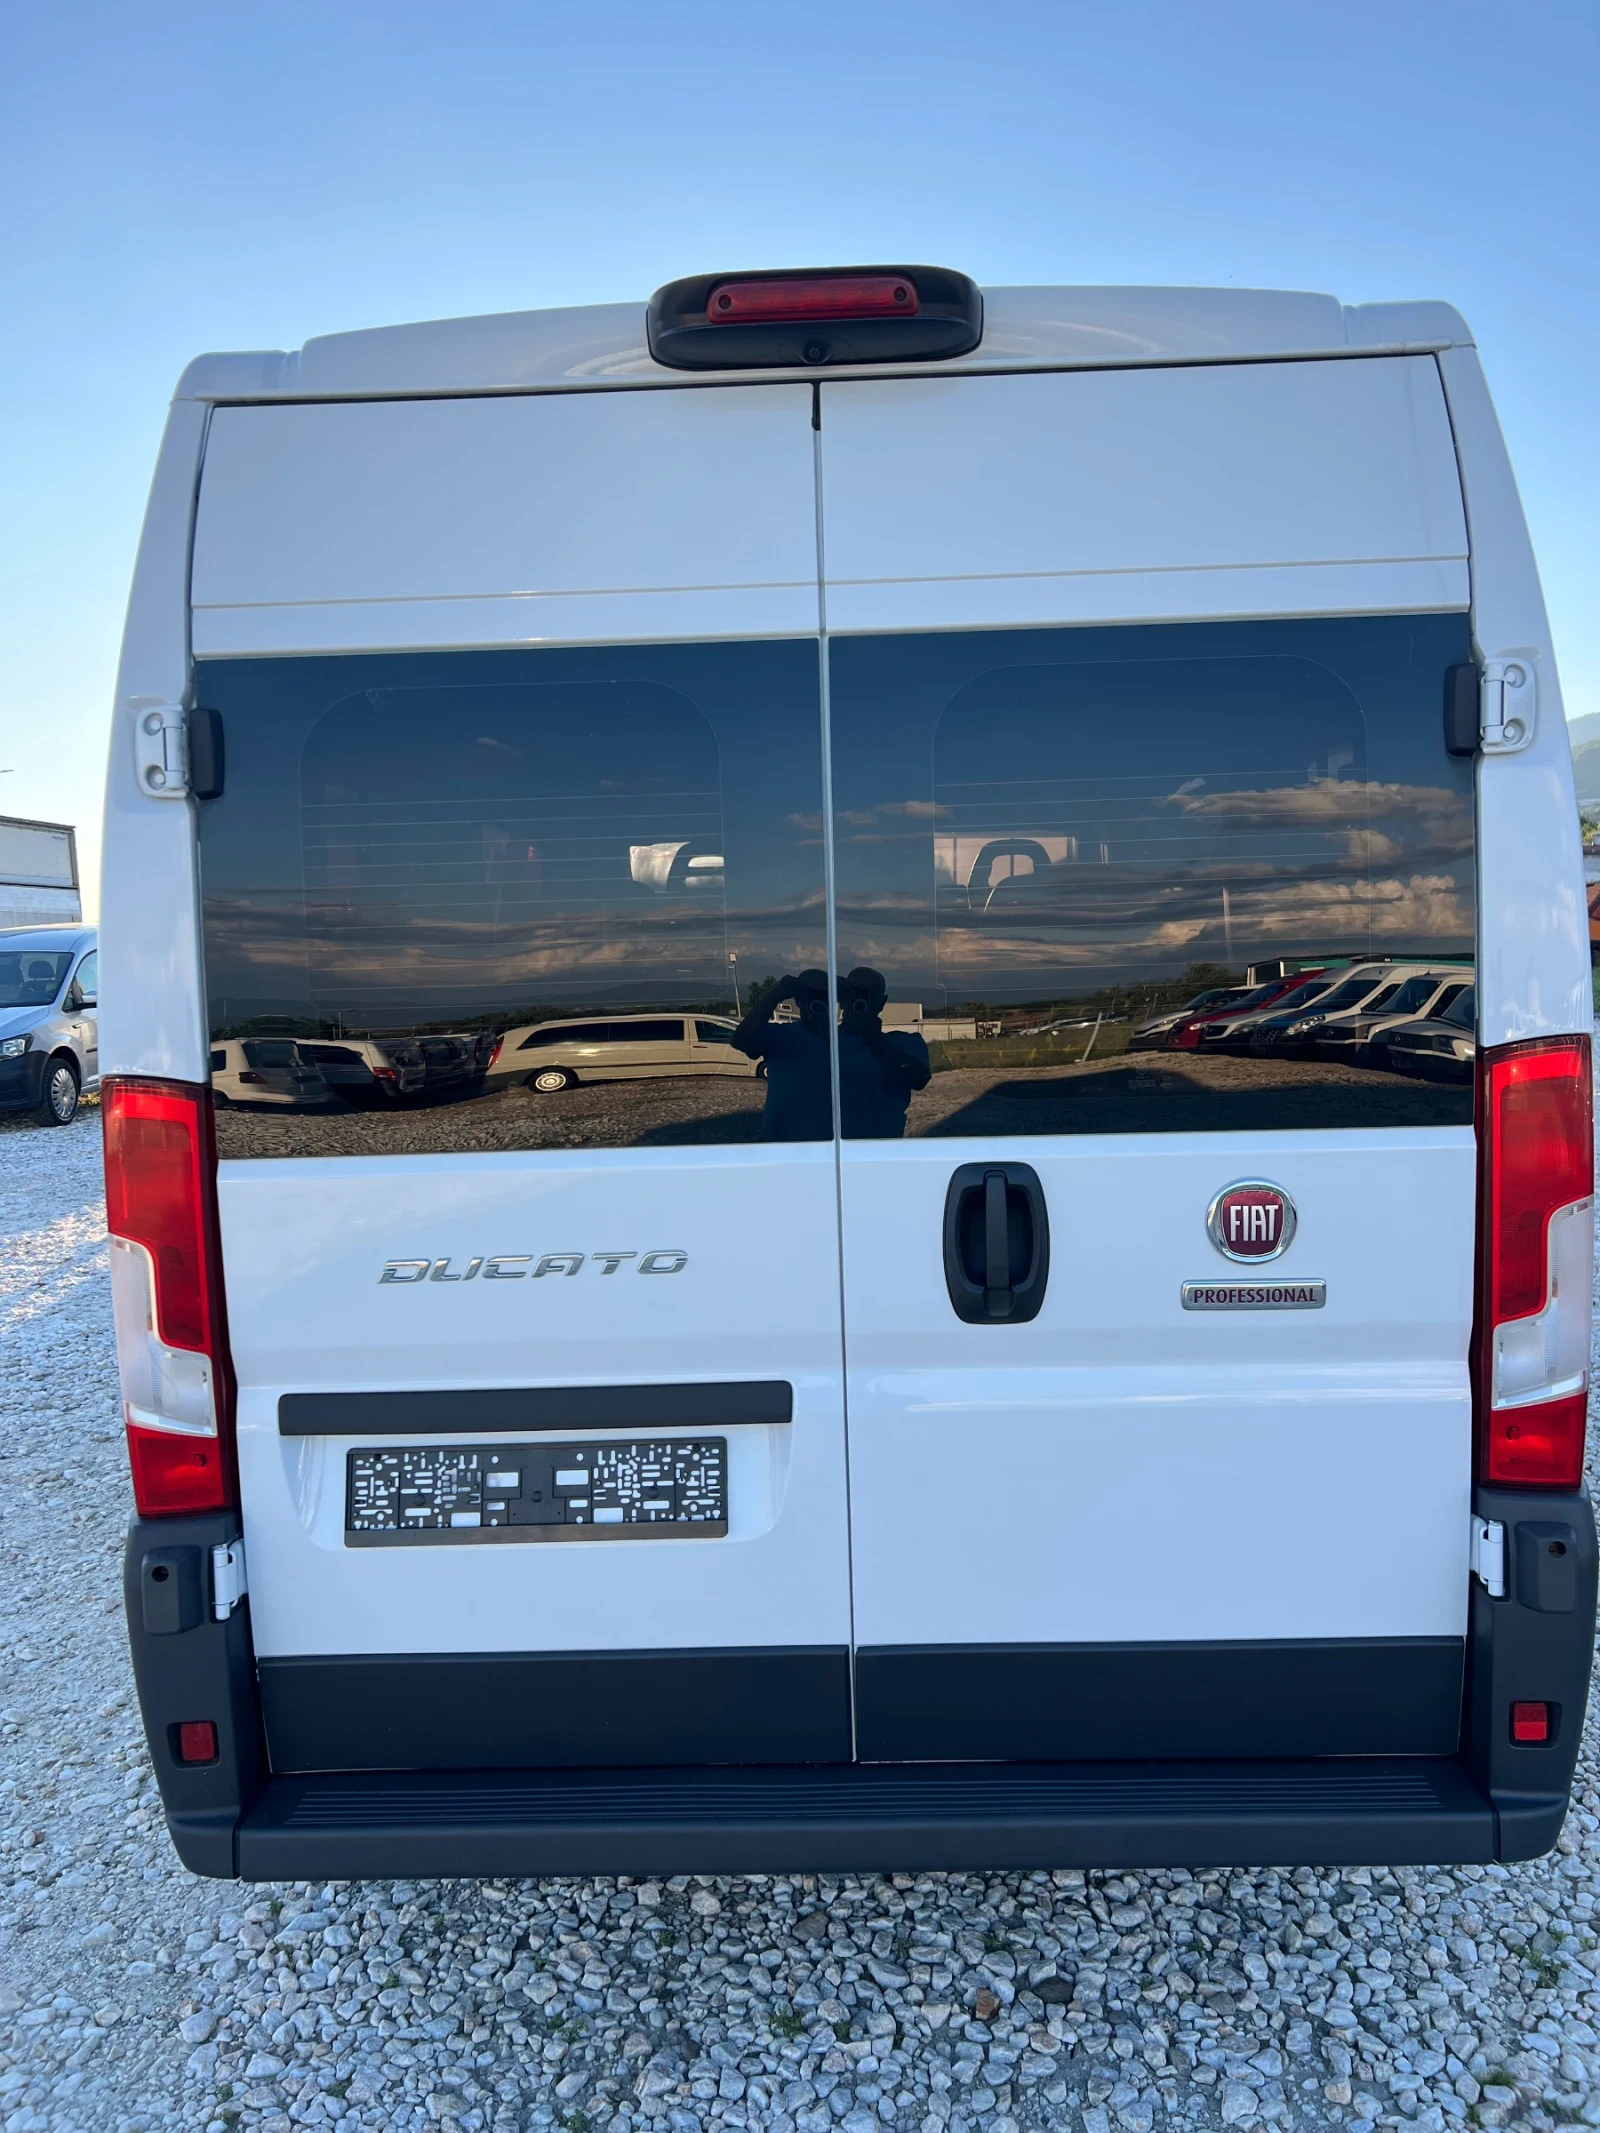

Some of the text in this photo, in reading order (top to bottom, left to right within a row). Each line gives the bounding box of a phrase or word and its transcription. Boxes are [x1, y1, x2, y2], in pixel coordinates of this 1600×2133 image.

[1229, 1204, 1279, 1242] FIAT
[377, 1249, 689, 1284] DUCATO
[1193, 1287, 1317, 1304] PROFESSIONAL
